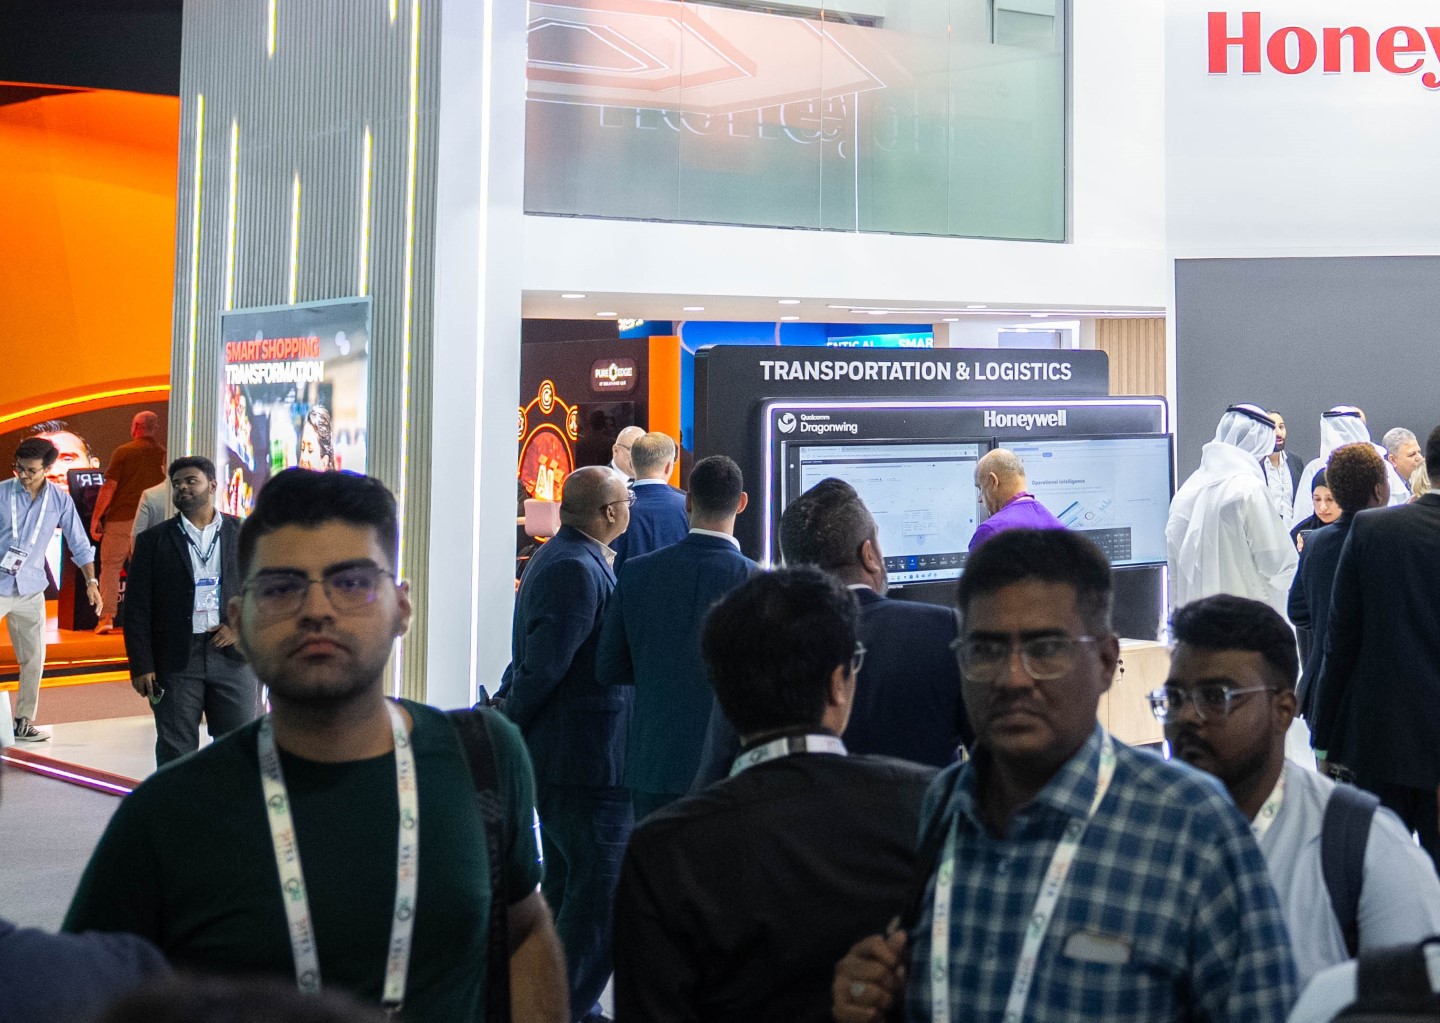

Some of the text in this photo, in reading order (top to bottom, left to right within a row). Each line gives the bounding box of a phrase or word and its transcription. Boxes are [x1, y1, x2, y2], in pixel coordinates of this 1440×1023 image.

[226, 336, 321, 363] SMART SHOPPING
[224, 361, 325, 385] TRANSFORMATION
[759, 361, 1072, 381] TRANSPORTATION & LOGISTICS
[800, 421, 858, 435] Dragonwing
[983, 409, 1067, 431] Honeywell
